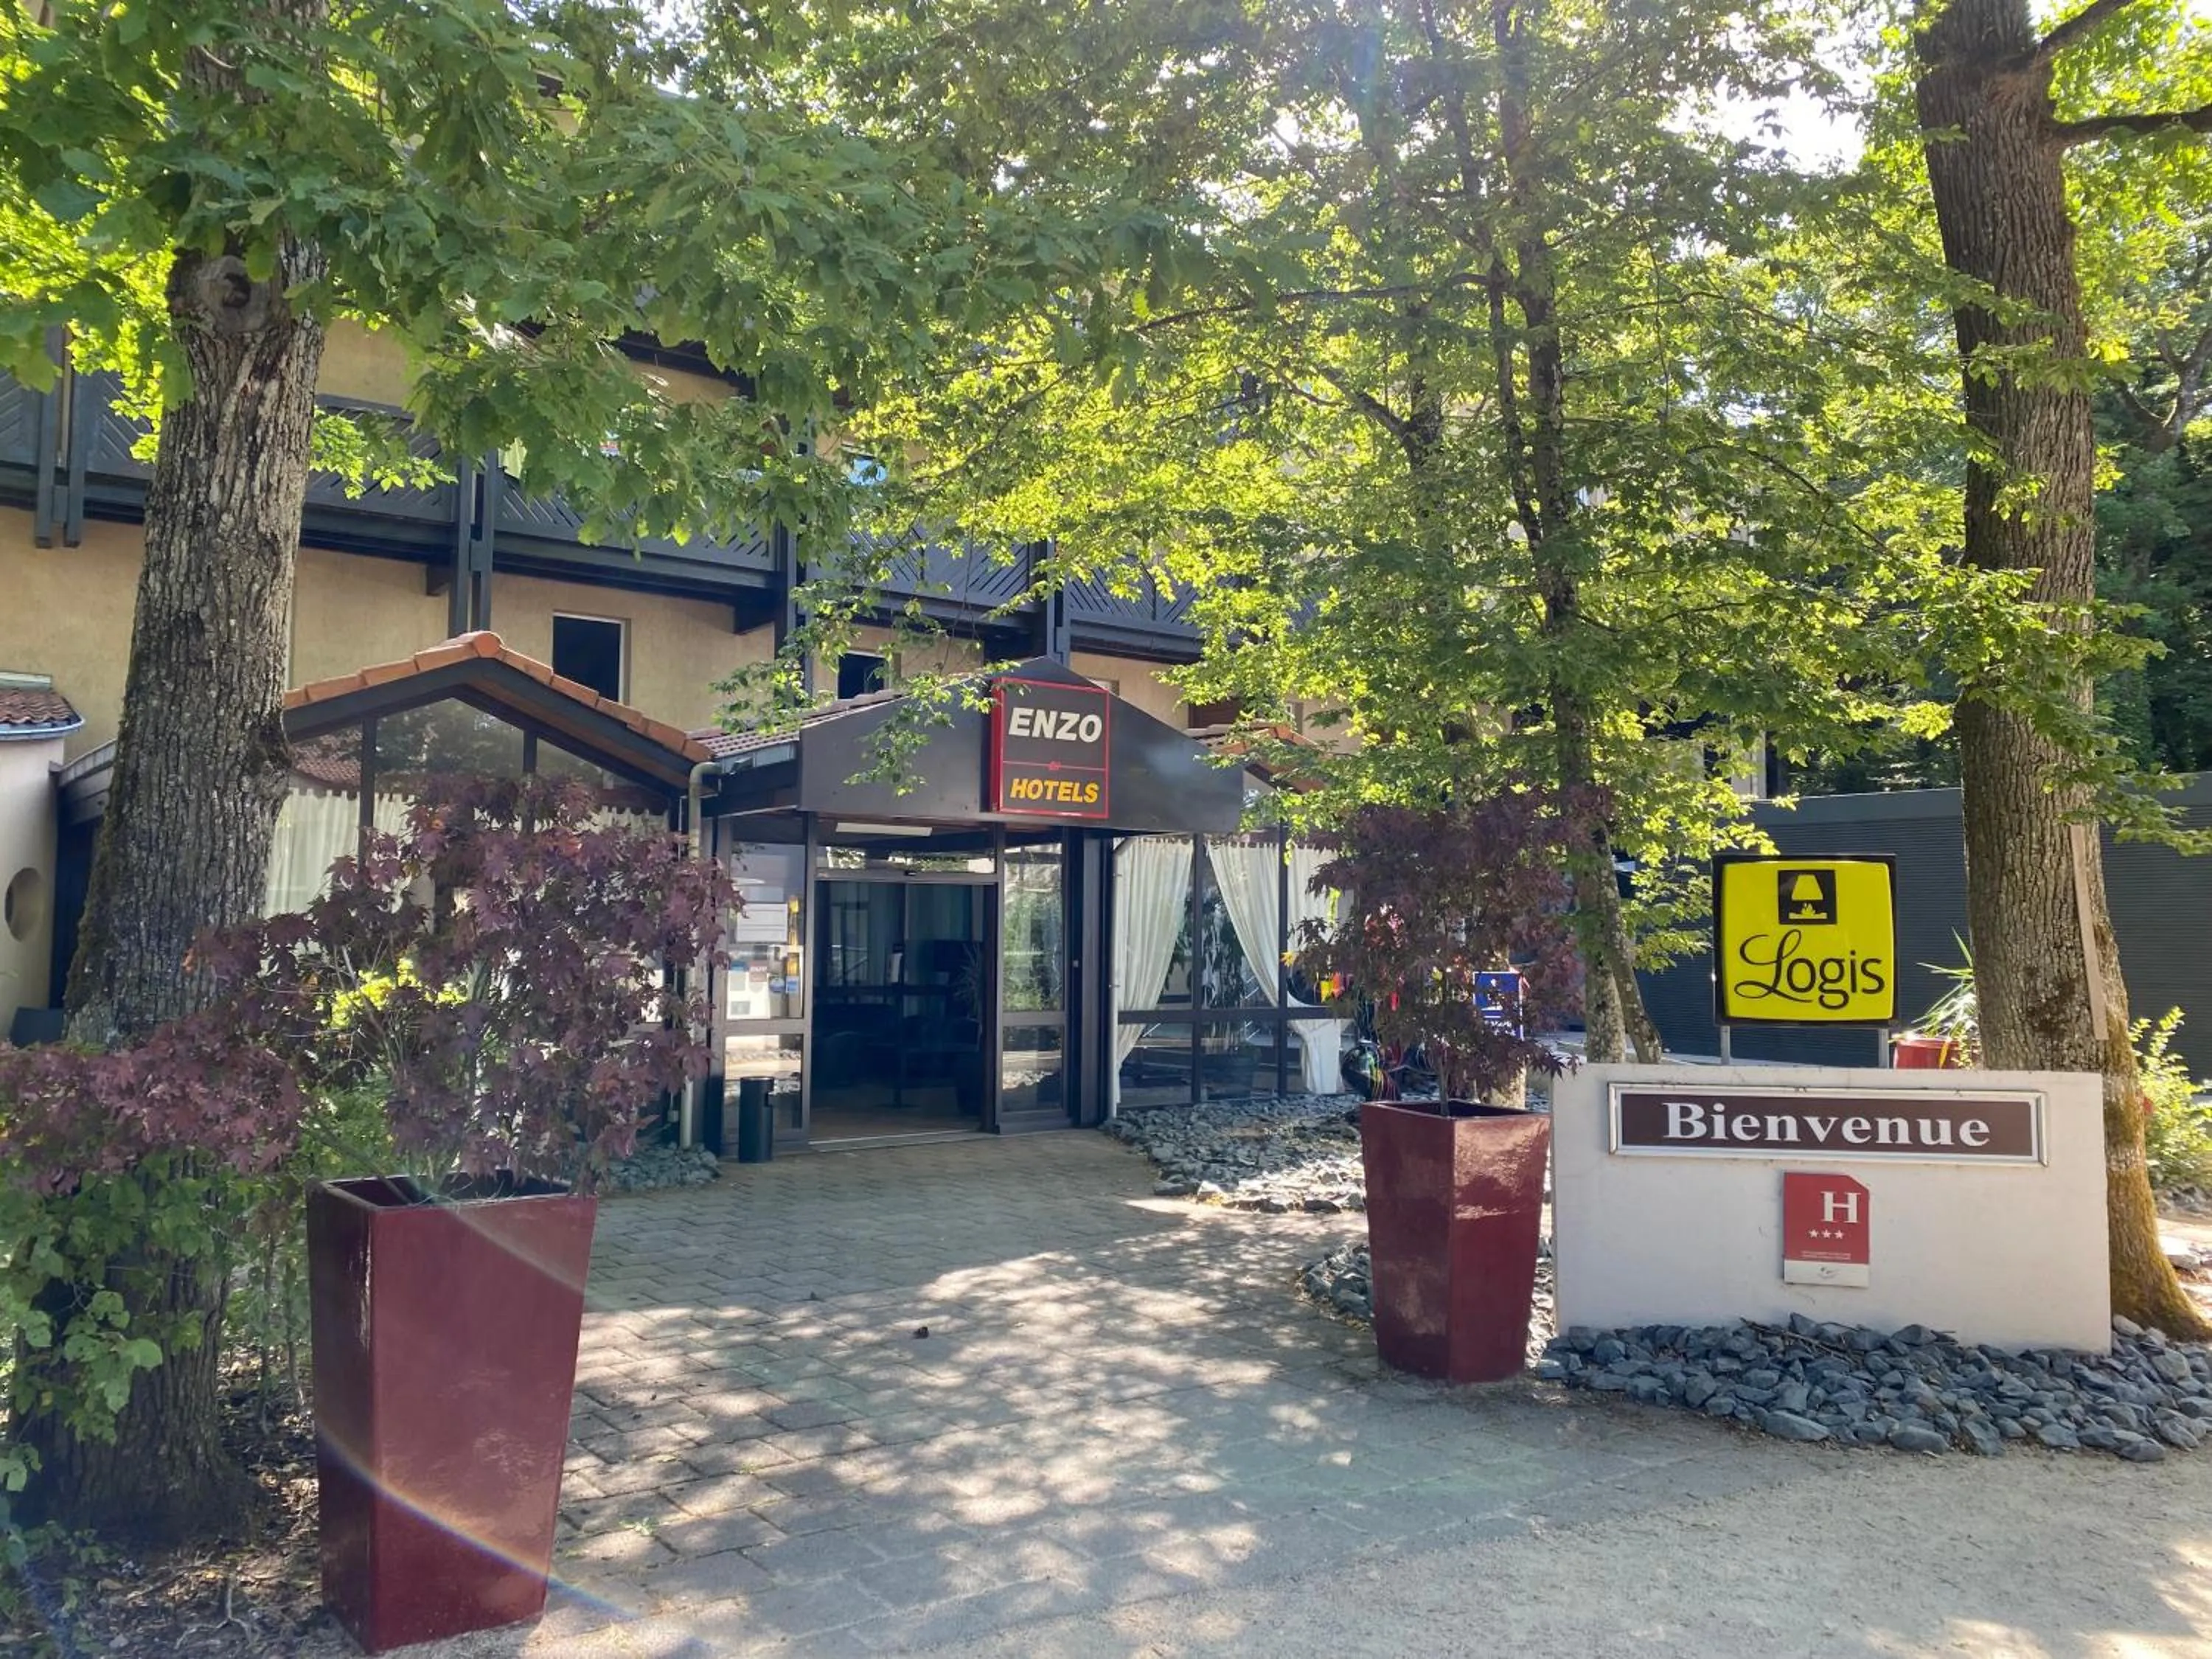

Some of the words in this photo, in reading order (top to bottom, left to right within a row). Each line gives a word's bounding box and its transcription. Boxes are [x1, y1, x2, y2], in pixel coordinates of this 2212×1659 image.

[1008, 707, 1102, 743] ENZO
[1009, 778, 1099, 803] HOTELS
[1733, 928, 1885, 1009] Logis
[1663, 1102, 1991, 1147] Bienvenue
[1820, 1191, 1862, 1223] H
